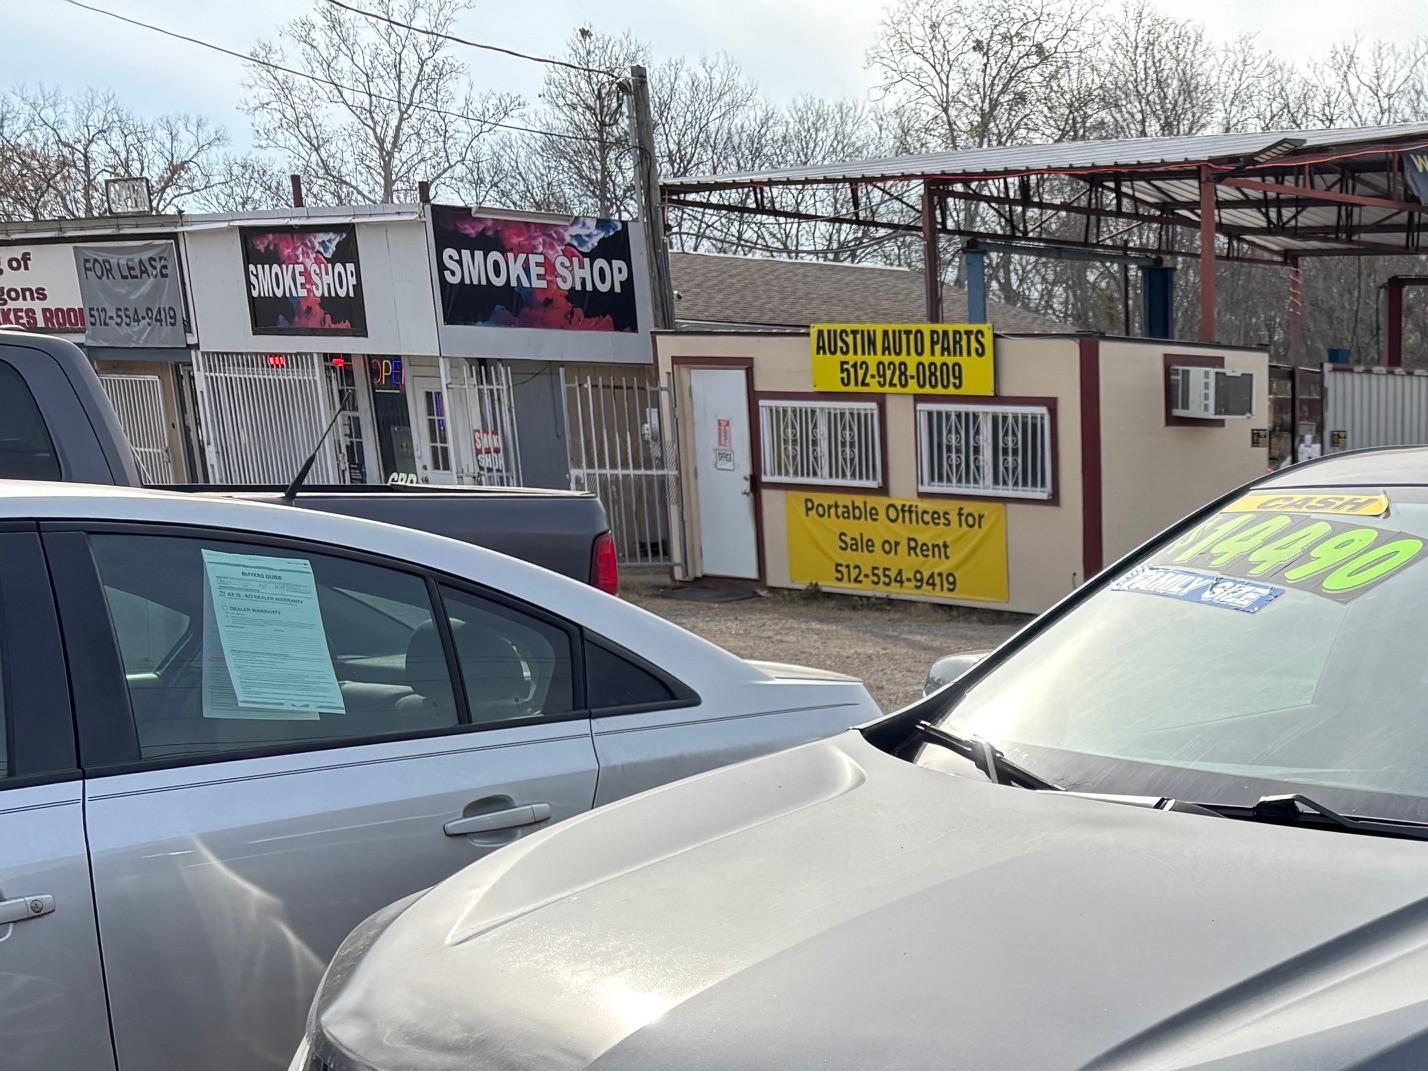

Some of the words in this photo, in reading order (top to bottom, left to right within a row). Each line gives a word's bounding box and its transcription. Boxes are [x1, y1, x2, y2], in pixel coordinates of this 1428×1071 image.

[7, 252, 31, 271] of
[83, 258, 116, 281] FOR
[117, 256, 169, 280] LEASE
[442, 248, 547, 289] SMOKE
[554, 254, 628, 294] SHOP
[248, 263, 308, 298] SMOKE
[310, 262, 357, 298] SHOP
[42, 308, 85, 328] ROO
[88, 306, 177, 328] 512-554-9419
[816, 329, 877, 357] AUSTIN
[881, 329, 925, 357] AUTO
[930, 329, 986, 358] PARTS
[840, 360, 963, 389] 512-928-0809
[804, 498, 879, 522] Portable
[885, 503, 951, 527] Offices
[957, 507, 985, 529] for
[1257, 496, 1380, 512] CASH
[838, 532, 875, 553] Sale
[881, 539, 900, 554] or
[907, 537, 950, 560] Rent
[834, 563, 957, 593] 512-554-9419
[1201, 581, 1271, 608] SIZE
